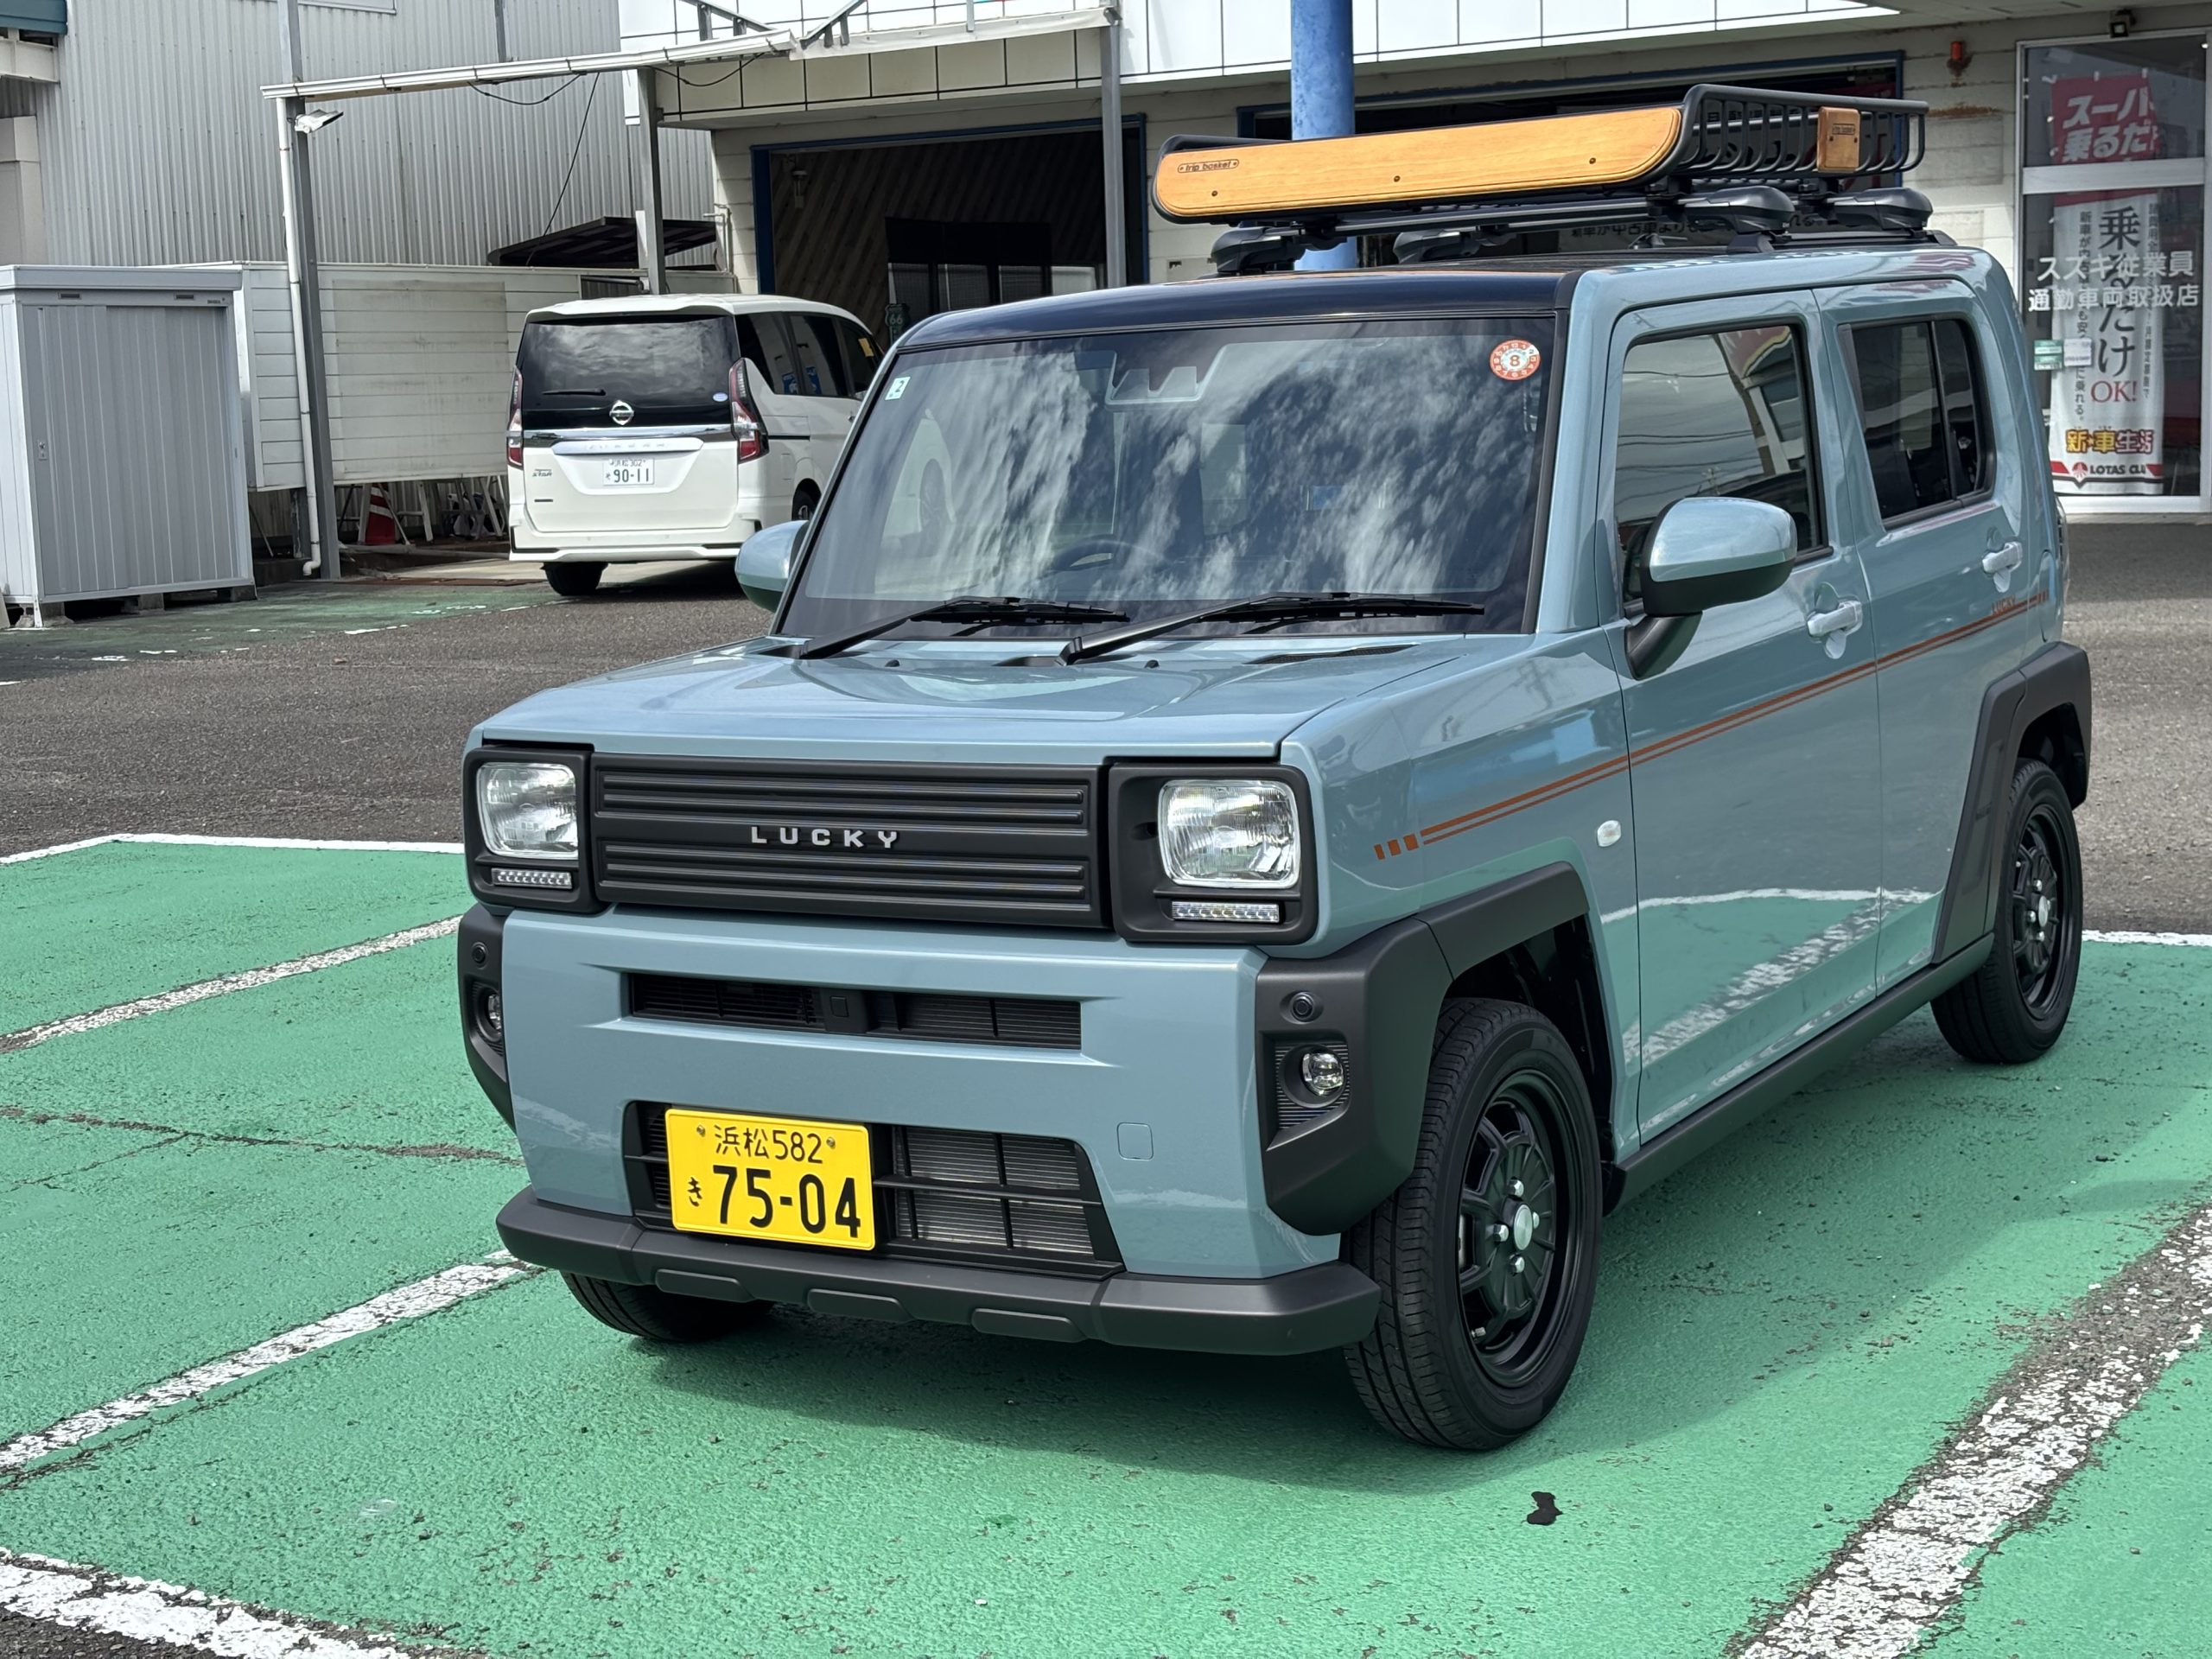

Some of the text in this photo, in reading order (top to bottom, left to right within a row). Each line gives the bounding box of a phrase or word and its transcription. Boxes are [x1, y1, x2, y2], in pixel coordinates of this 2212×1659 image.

[1510, 354, 1521, 367] 8
[895, 380, 906, 393] 2
[2090, 380, 2138, 404] OK!
[613, 467, 649, 483] 90-11
[2090, 464, 2126, 474] LOTAS
[750, 826, 898, 849] LUCKY
[713, 1123, 823, 1165] 浜松582
[688, 1164, 861, 1239] き 75-04
